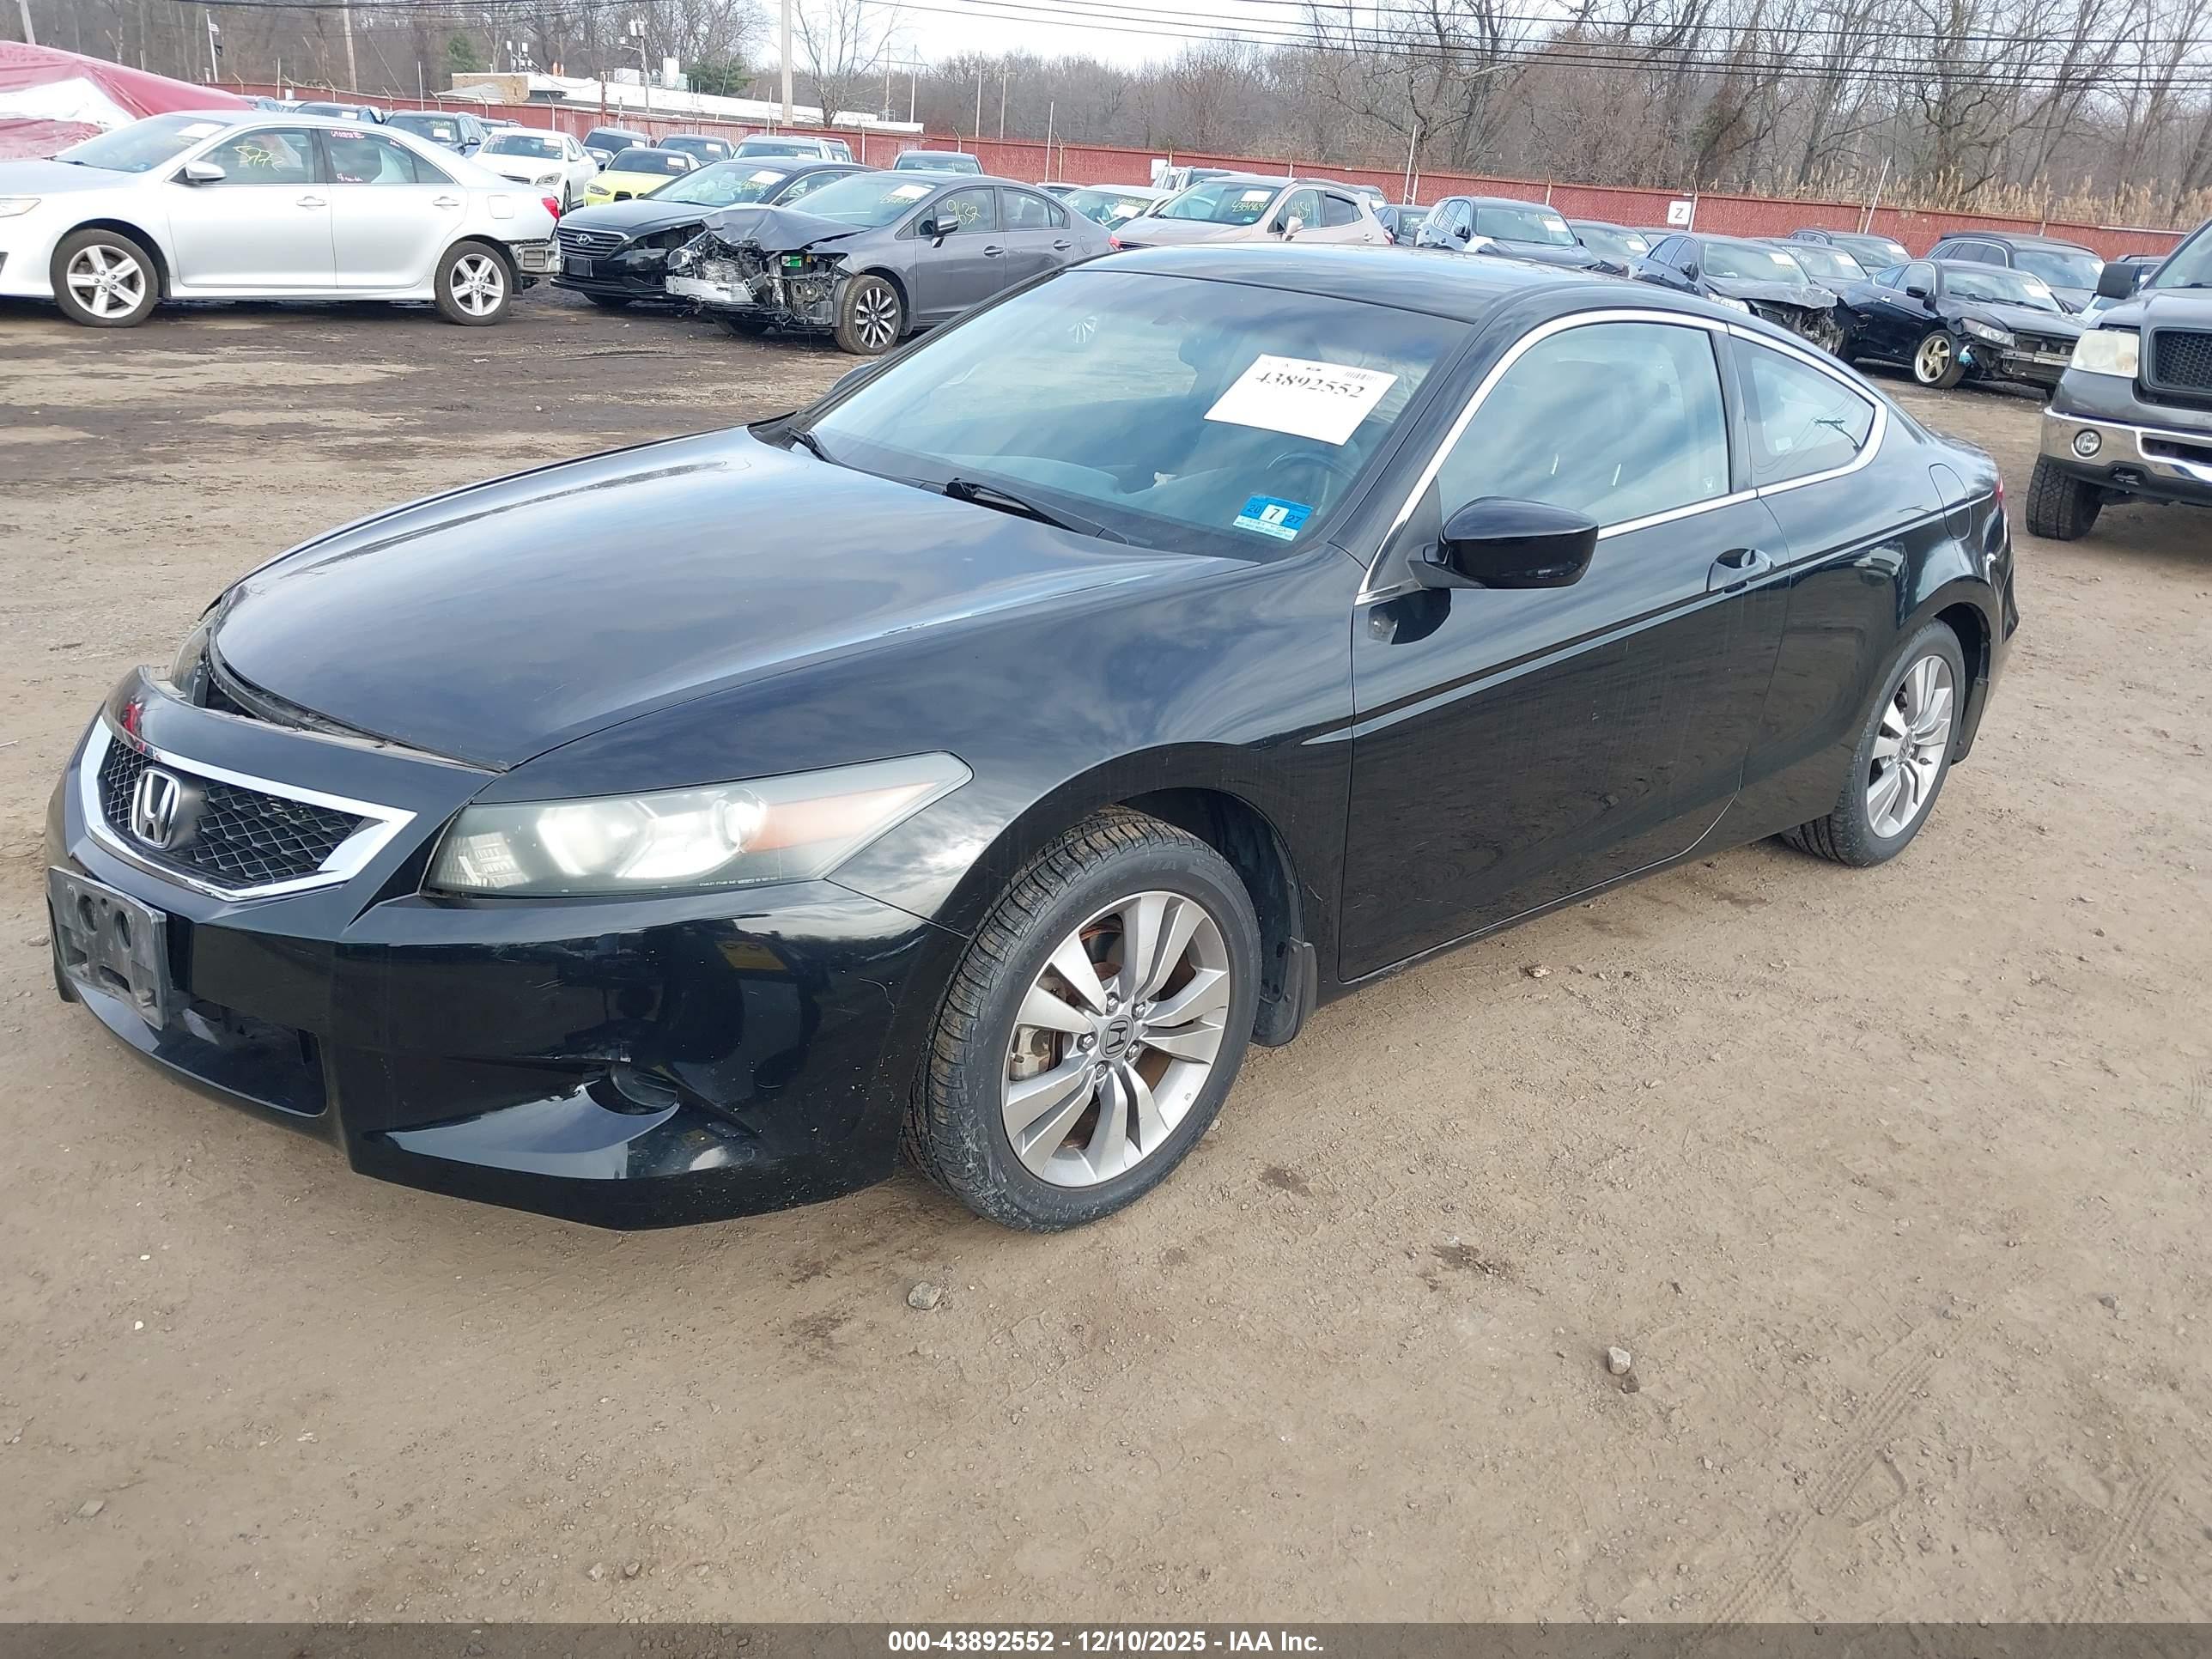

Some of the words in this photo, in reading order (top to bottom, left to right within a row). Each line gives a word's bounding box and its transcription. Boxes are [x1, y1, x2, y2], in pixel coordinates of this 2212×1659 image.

[1674, 207, 1684, 219] Z
[1255, 371, 1365, 398] 43892552
[1247, 504, 1262, 514] 20
[1269, 507, 1280, 520] 7
[1286, 514, 1303, 525] 27
